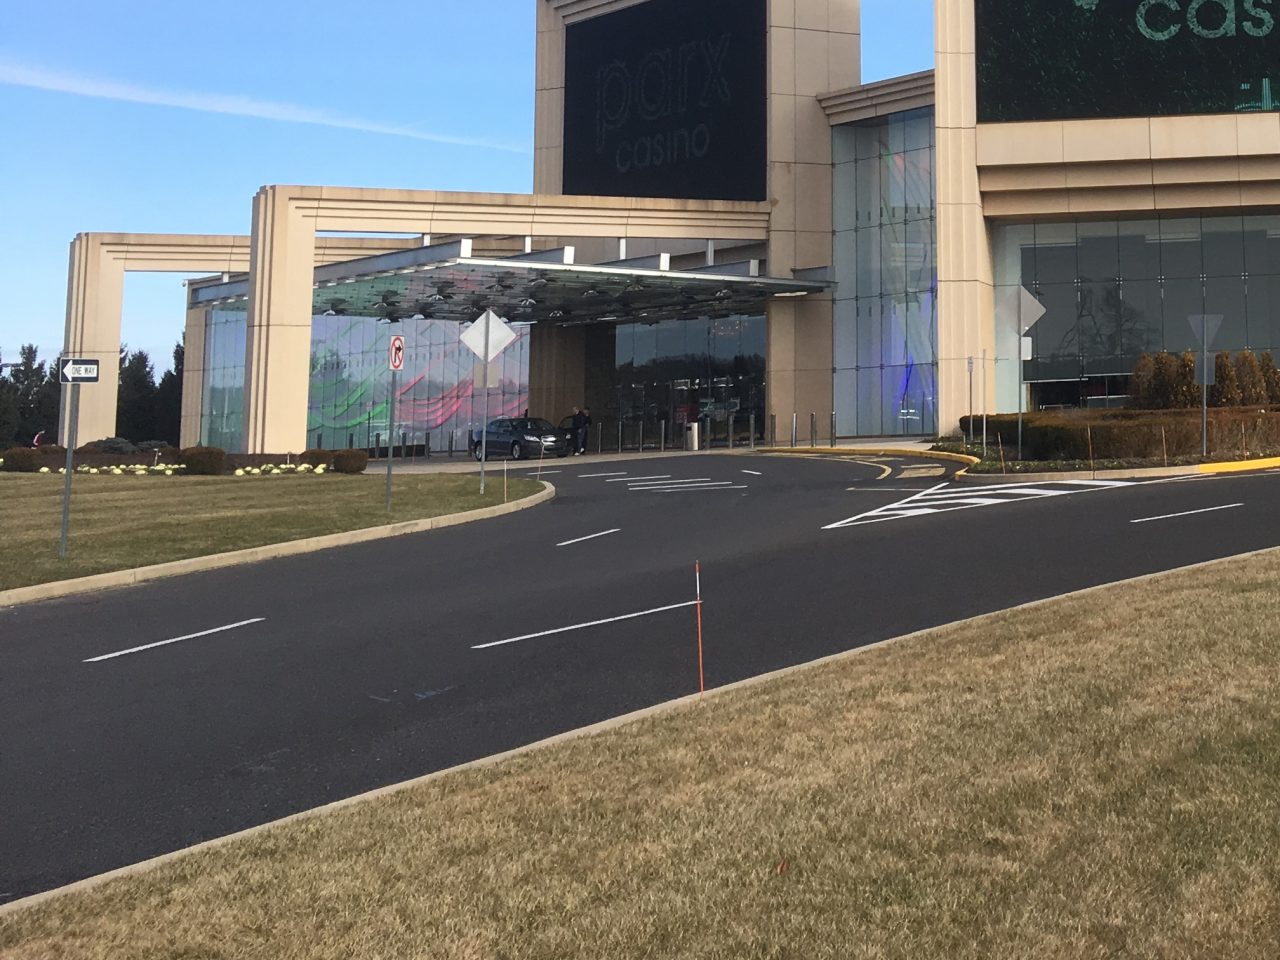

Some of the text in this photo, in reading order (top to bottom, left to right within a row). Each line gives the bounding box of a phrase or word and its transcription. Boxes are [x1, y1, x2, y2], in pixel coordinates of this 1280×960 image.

[595, 32, 733, 154] parx
[615, 123, 711, 174] casino
[71, 366, 95, 376] ONE WAY
